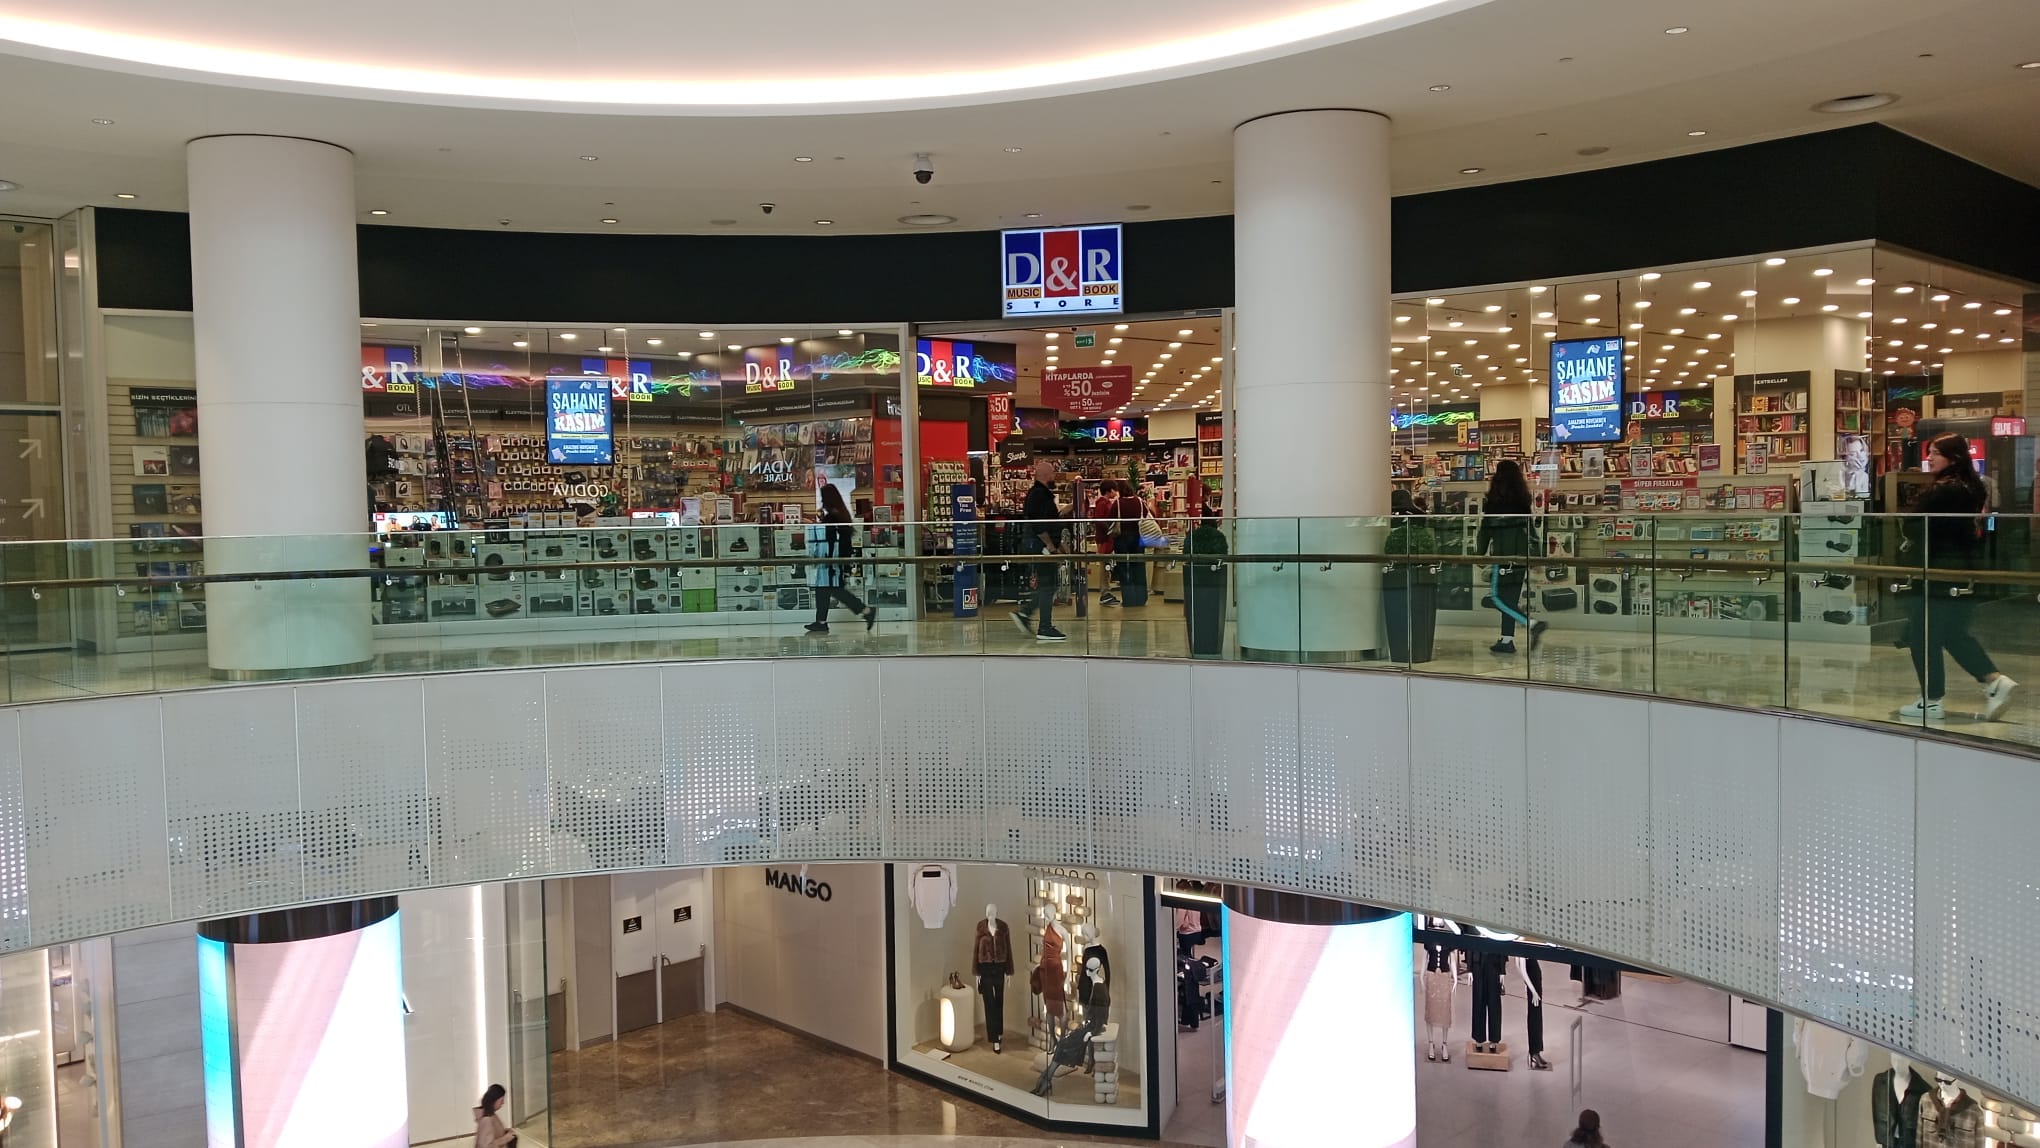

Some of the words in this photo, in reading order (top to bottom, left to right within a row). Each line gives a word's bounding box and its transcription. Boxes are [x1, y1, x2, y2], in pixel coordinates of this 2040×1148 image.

[1008, 248, 1112, 292] D&R
[1007, 287, 1040, 298] MUSIC
[1084, 284, 1116, 295] BOOK
[1007, 297, 1119, 310] STORE
[746, 359, 791, 388] D&R
[1557, 381, 1616, 404] KASIM
[1632, 399, 1678, 417] D&R
[554, 413, 606, 432] KASIM
[1096, 426, 1132, 441] D&R
[766, 868, 832, 902] MANGO
